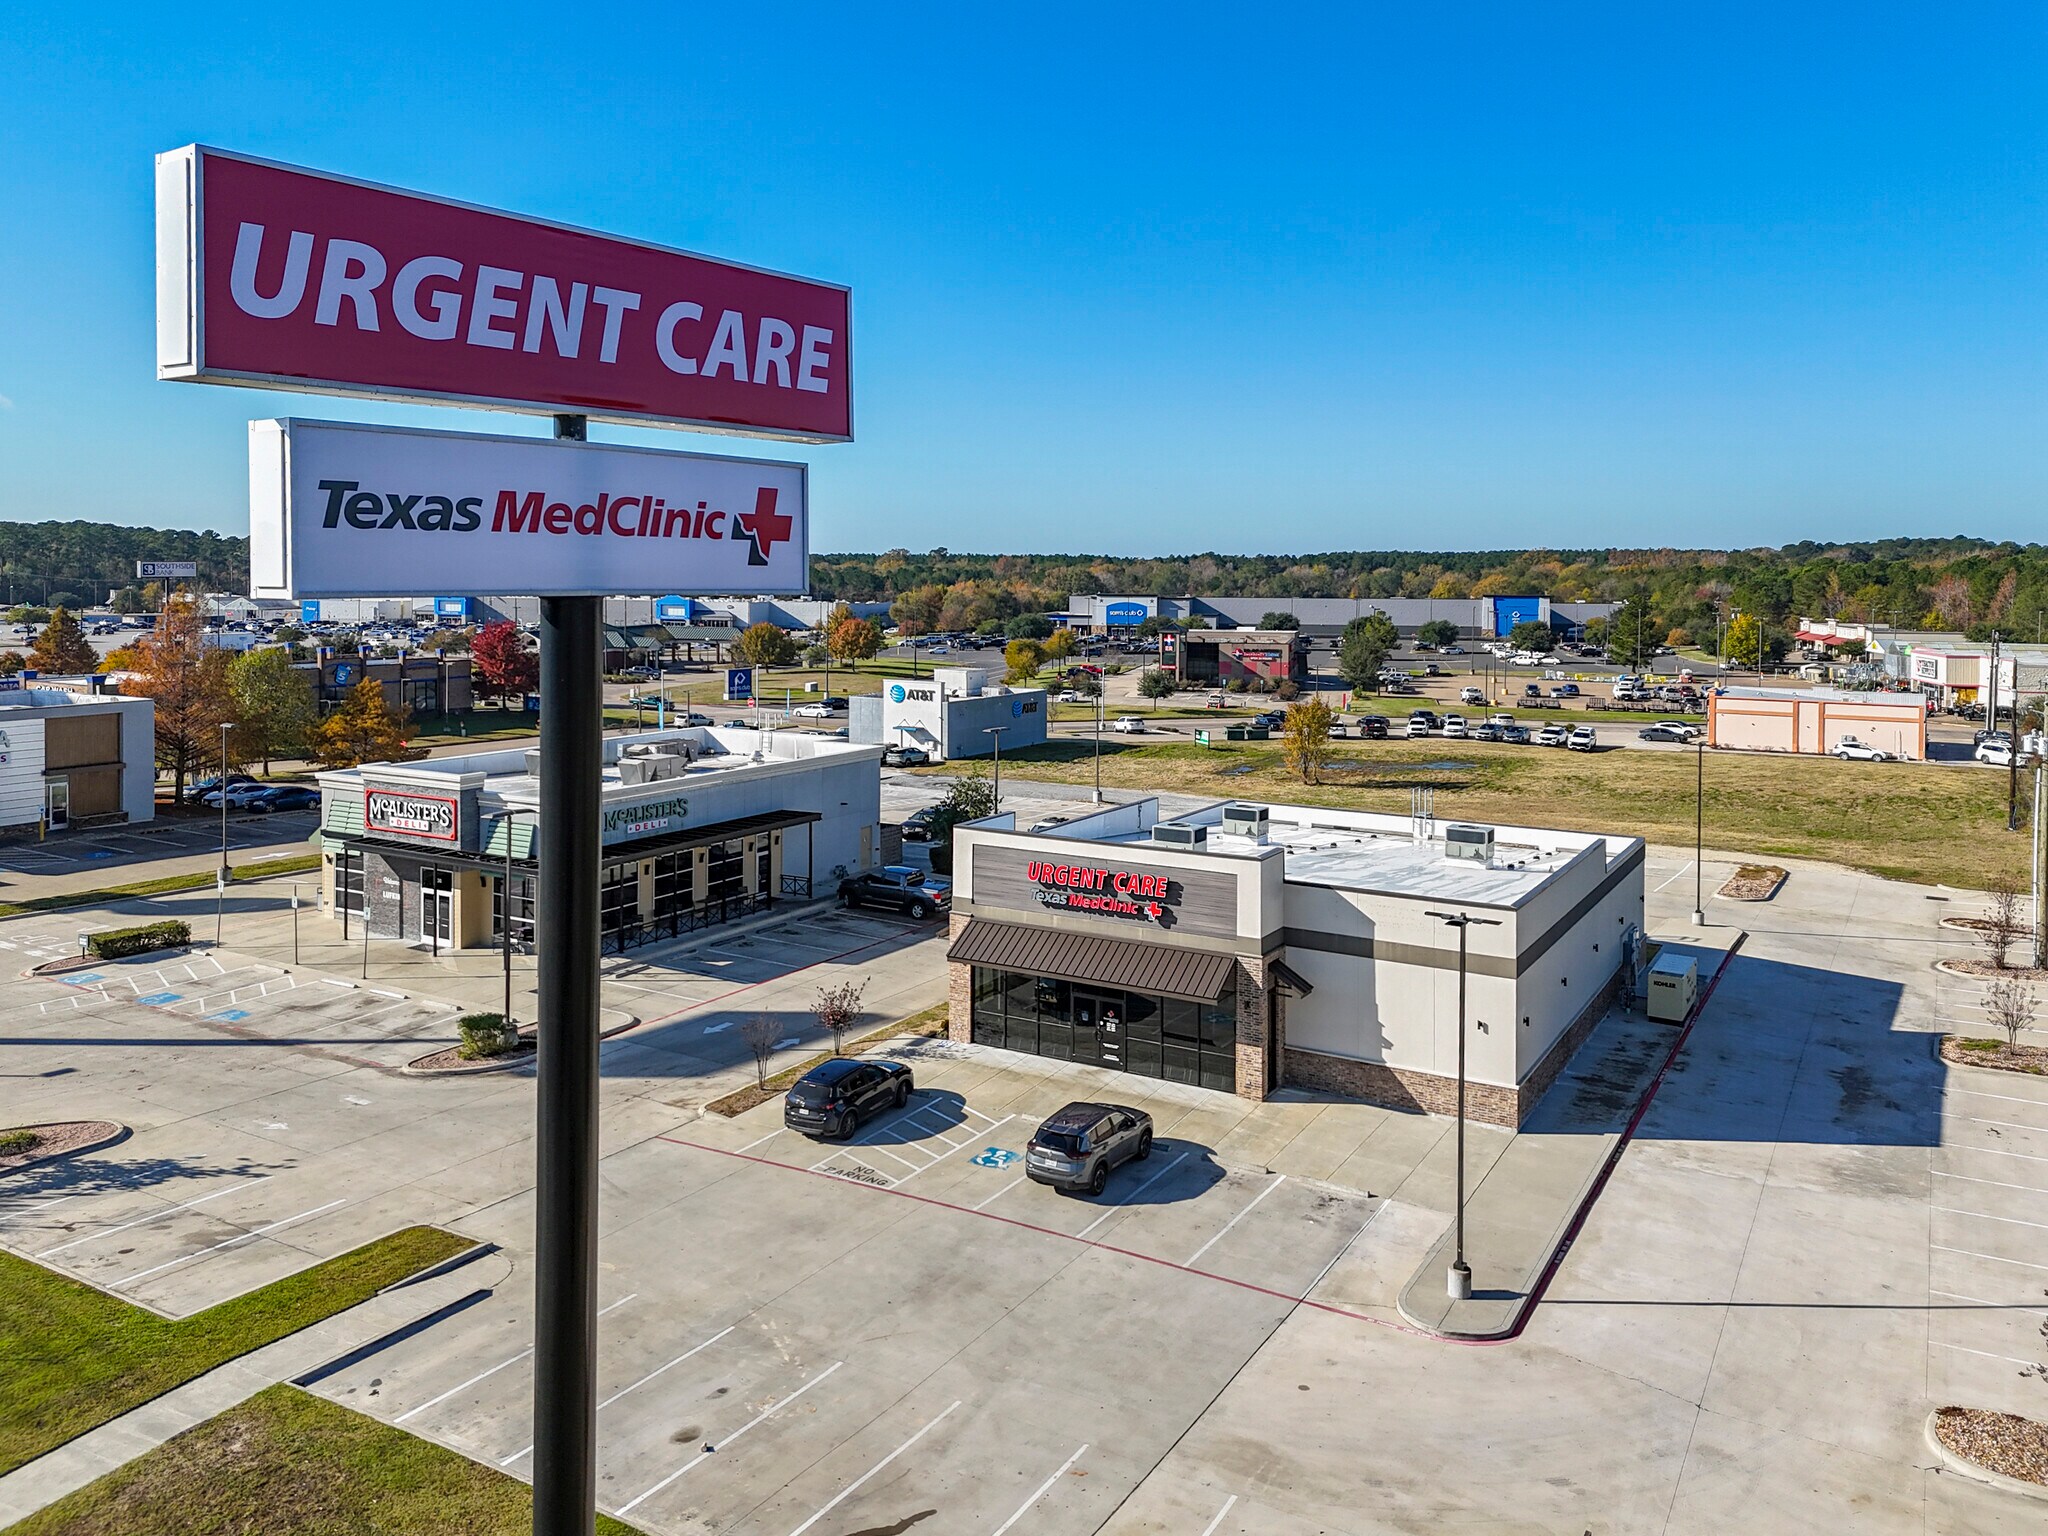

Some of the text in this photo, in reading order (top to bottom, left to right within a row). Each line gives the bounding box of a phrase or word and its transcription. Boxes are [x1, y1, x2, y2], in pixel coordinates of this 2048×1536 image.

[229, 222, 834, 394] URGENT CARE
[317, 480, 726, 540] Texas MedClinic
[907, 689, 936, 702] AT&T
[369, 798, 450, 827] McALISTER'S
[396, 819, 421, 829] DELI
[635, 821, 661, 831] DELI
[1027, 861, 1169, 898] URGENT CARE
[1030, 888, 1139, 915] Texas MedClinic
[1653, 980, 1676, 989] KOHLER
[823, 1166, 889, 1187] PARKING
[852, 1166, 876, 1175] NO
